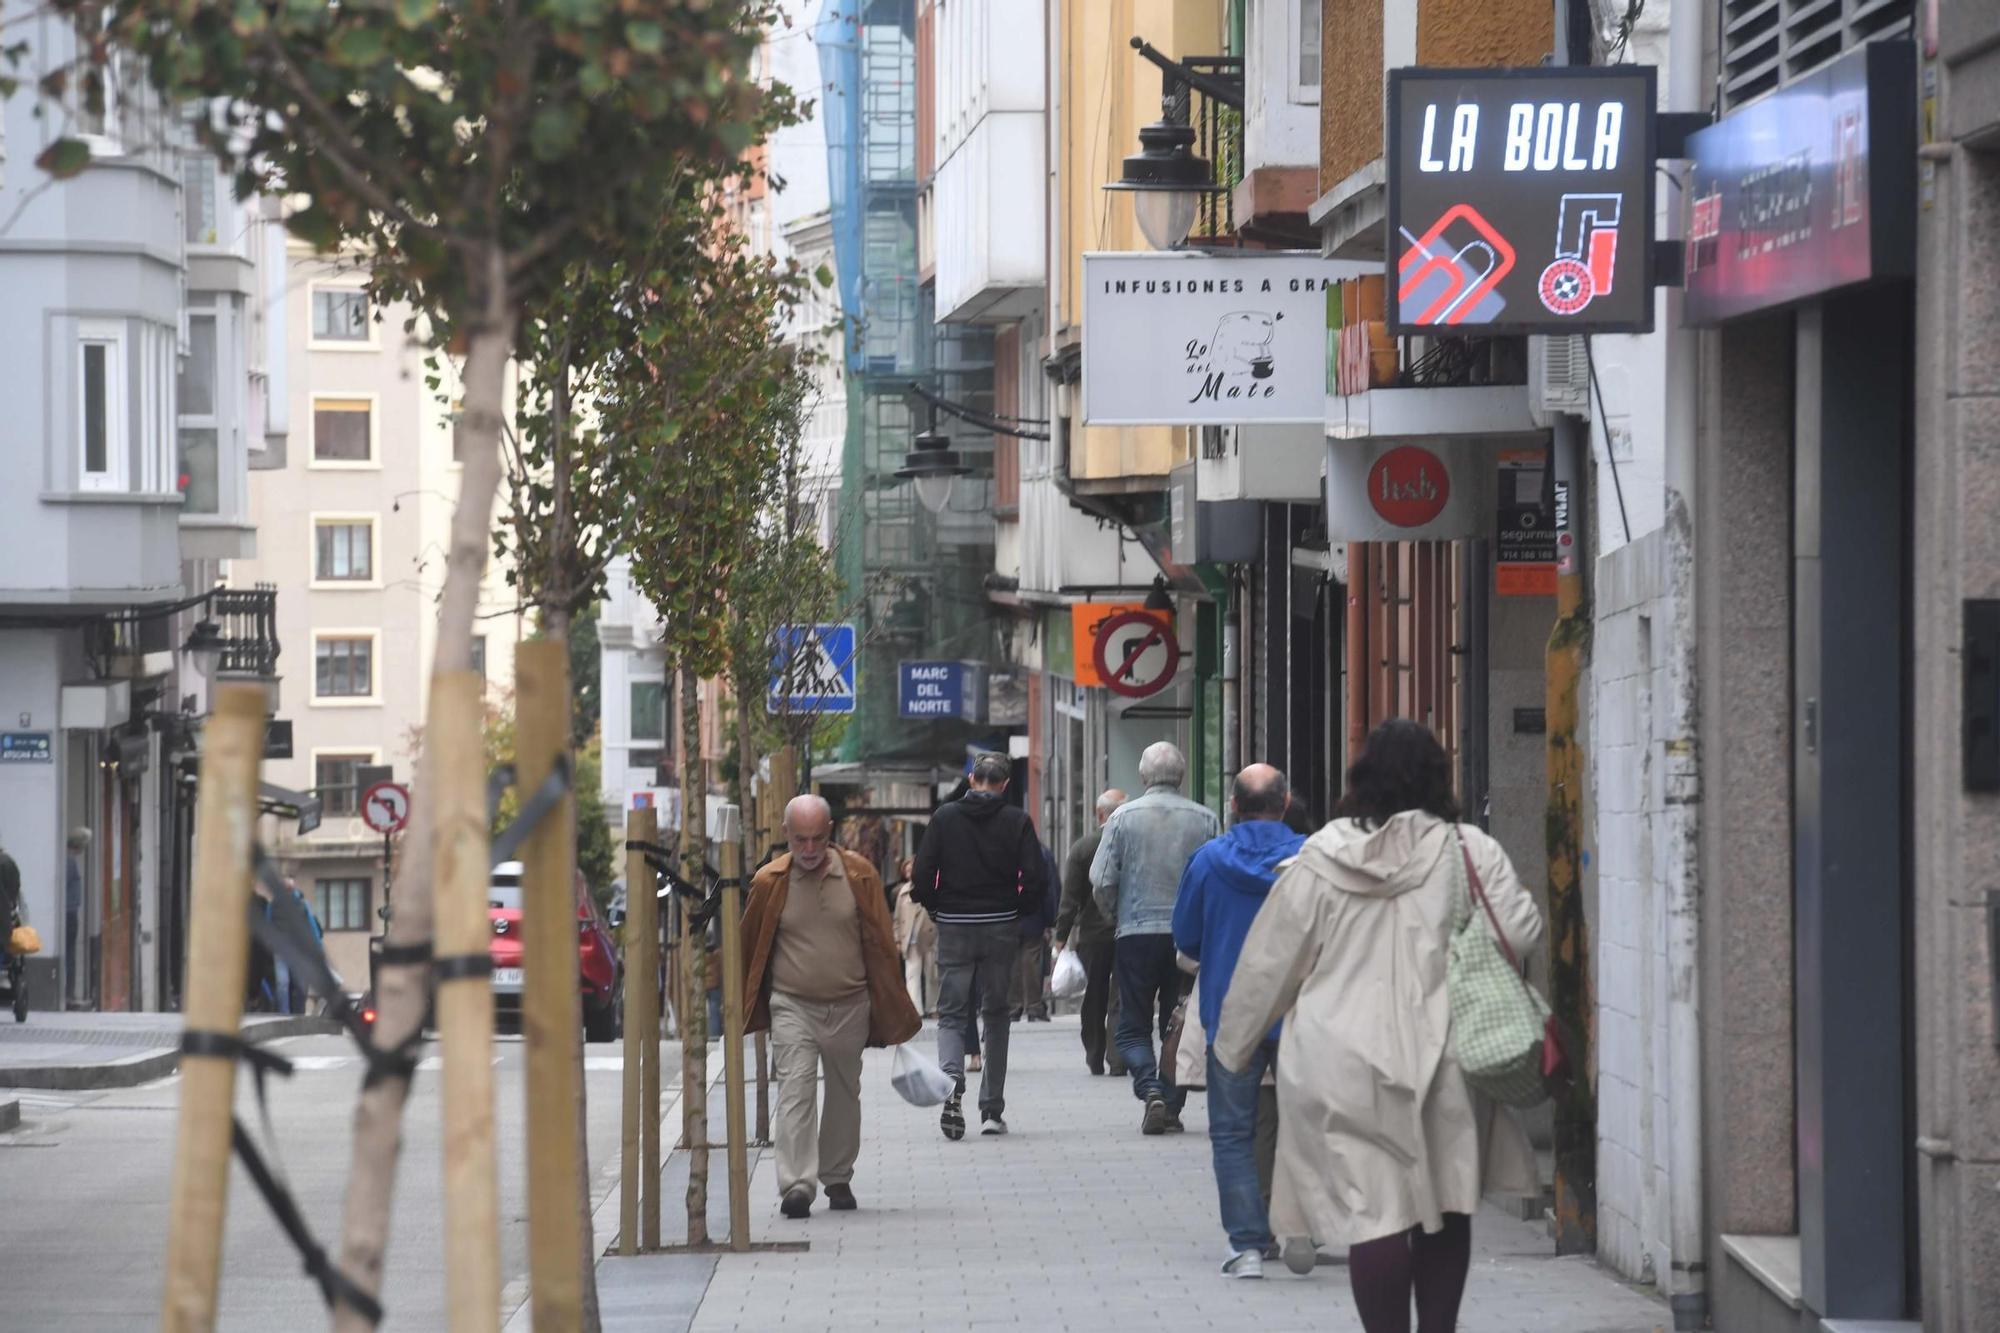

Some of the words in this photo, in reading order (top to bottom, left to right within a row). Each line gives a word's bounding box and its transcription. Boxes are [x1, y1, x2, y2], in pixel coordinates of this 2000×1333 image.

[1419, 103, 1480, 172] LA
[1503, 101, 1624, 171] BOLA
[1104, 279, 1244, 294] INFUSIONES
[1260, 279, 1272, 292] A
[1188, 371, 1275, 403] Mate
[917, 683, 943, 697] DEL
[908, 699, 952, 713] NORTE
